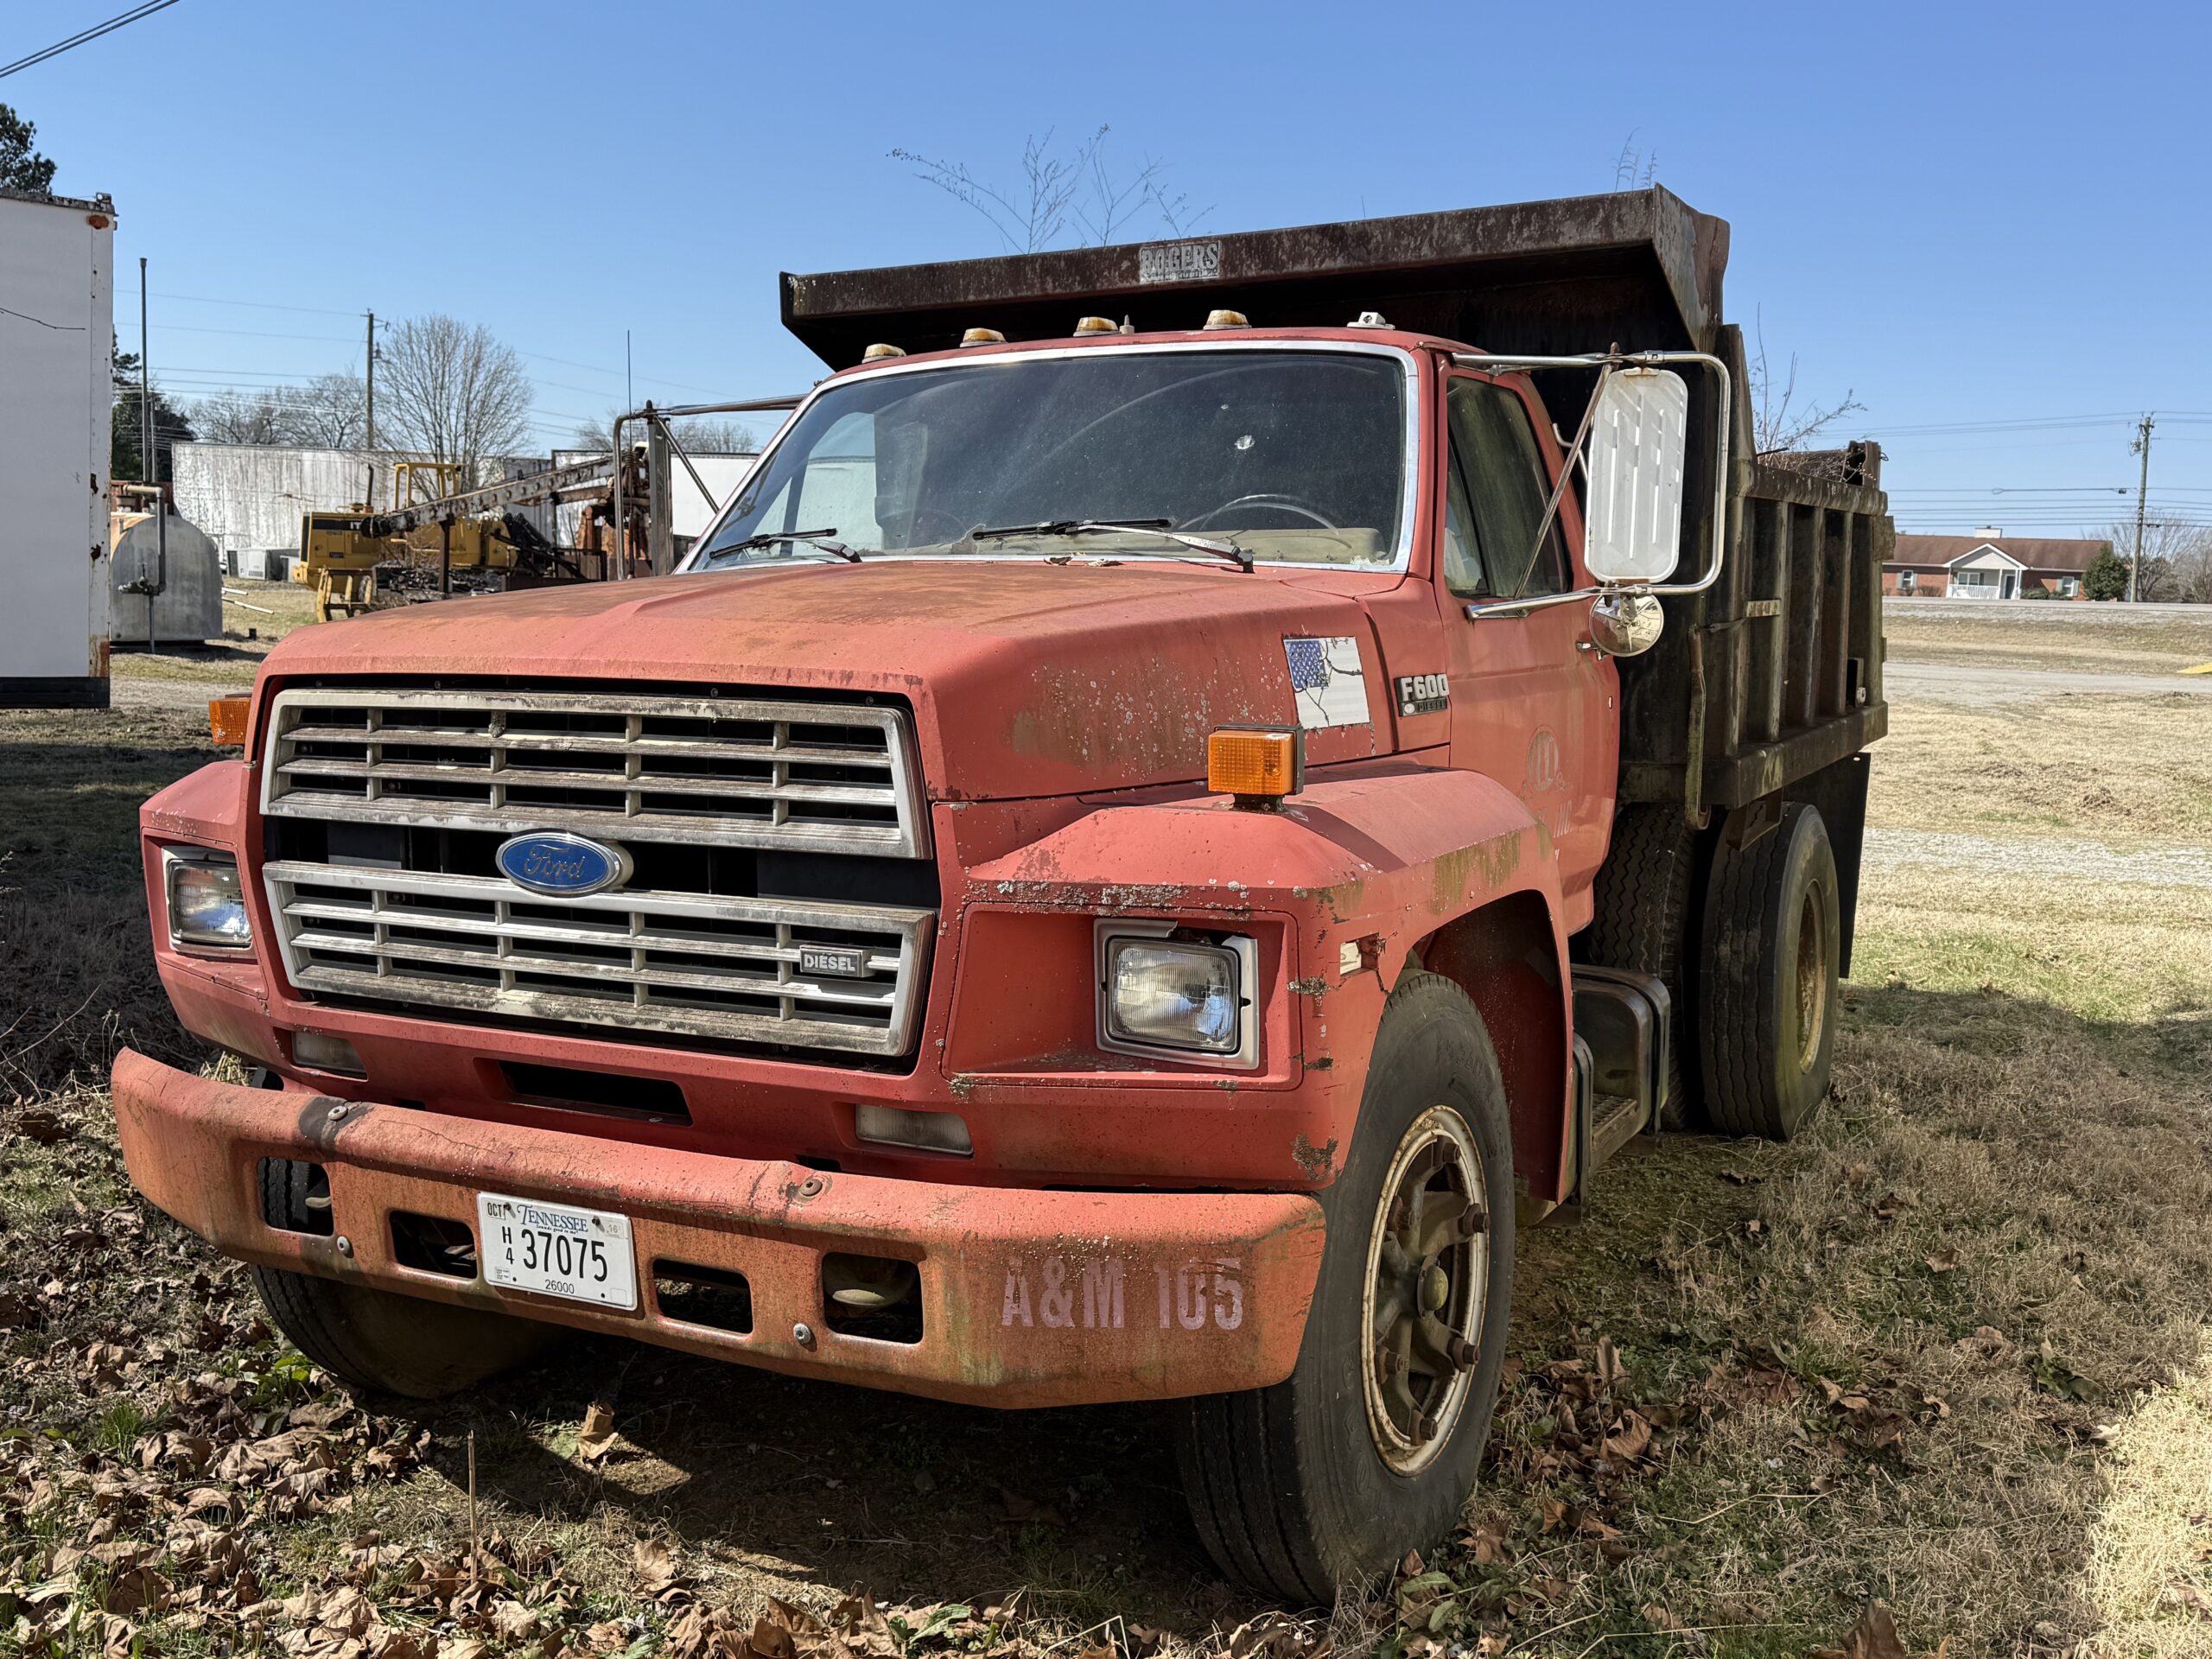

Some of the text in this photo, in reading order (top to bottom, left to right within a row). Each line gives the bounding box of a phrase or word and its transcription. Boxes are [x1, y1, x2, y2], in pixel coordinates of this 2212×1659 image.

[1141, 243, 1217, 273] ROGERS
[1401, 674, 1450, 702] F600
[524, 844, 585, 878] Ford
[804, 954, 855, 971] DIESEL
[486, 1202, 502, 1217] OCT
[517, 1205, 588, 1232] TENNESSEE
[502, 1226, 512, 1244] H
[506, 1247, 515, 1265] 4
[521, 1229, 607, 1282] 37075
[545, 1279, 575, 1294] 26000
[1001, 1256, 1243, 1331] A&M 105
